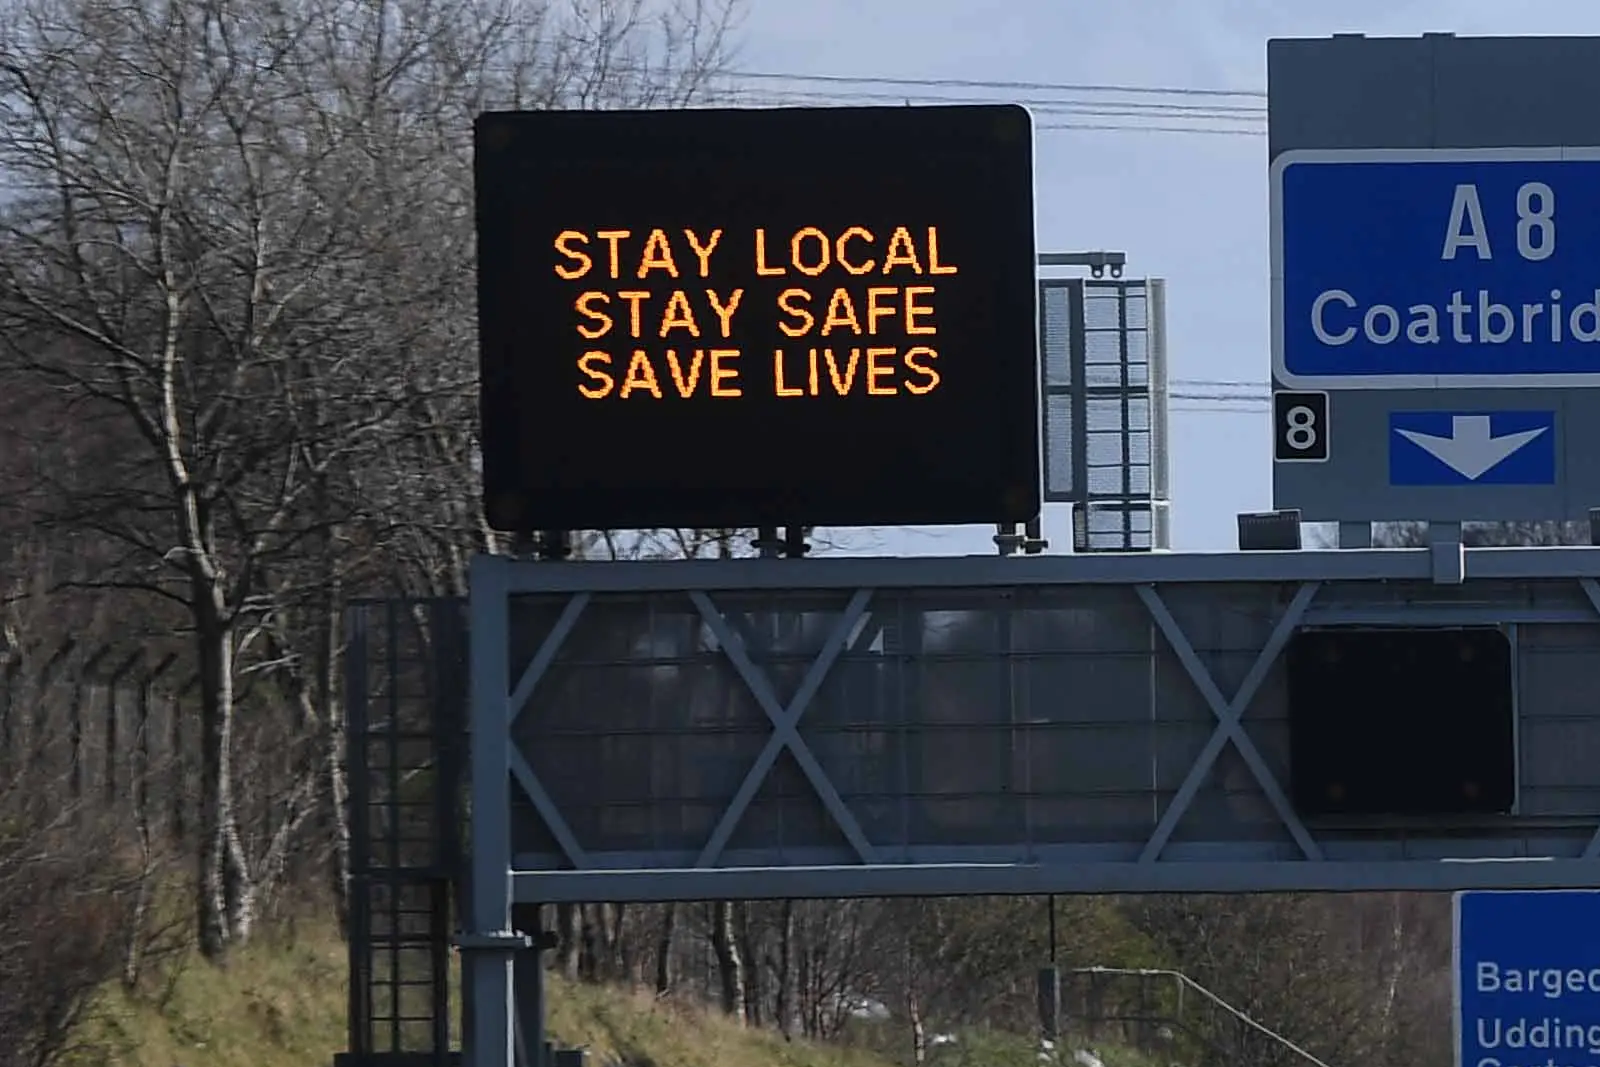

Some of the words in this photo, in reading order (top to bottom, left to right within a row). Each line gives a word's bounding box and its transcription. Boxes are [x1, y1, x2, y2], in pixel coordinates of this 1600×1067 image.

[555, 229, 722, 279] STAY
[756, 227, 957, 276] LOCAL
[576, 289, 743, 338] STAY
[778, 287, 936, 336] SAFE
[578, 350, 741, 398] SAVE
[775, 347, 939, 396] LIVES
[1287, 406, 1315, 449] 8
